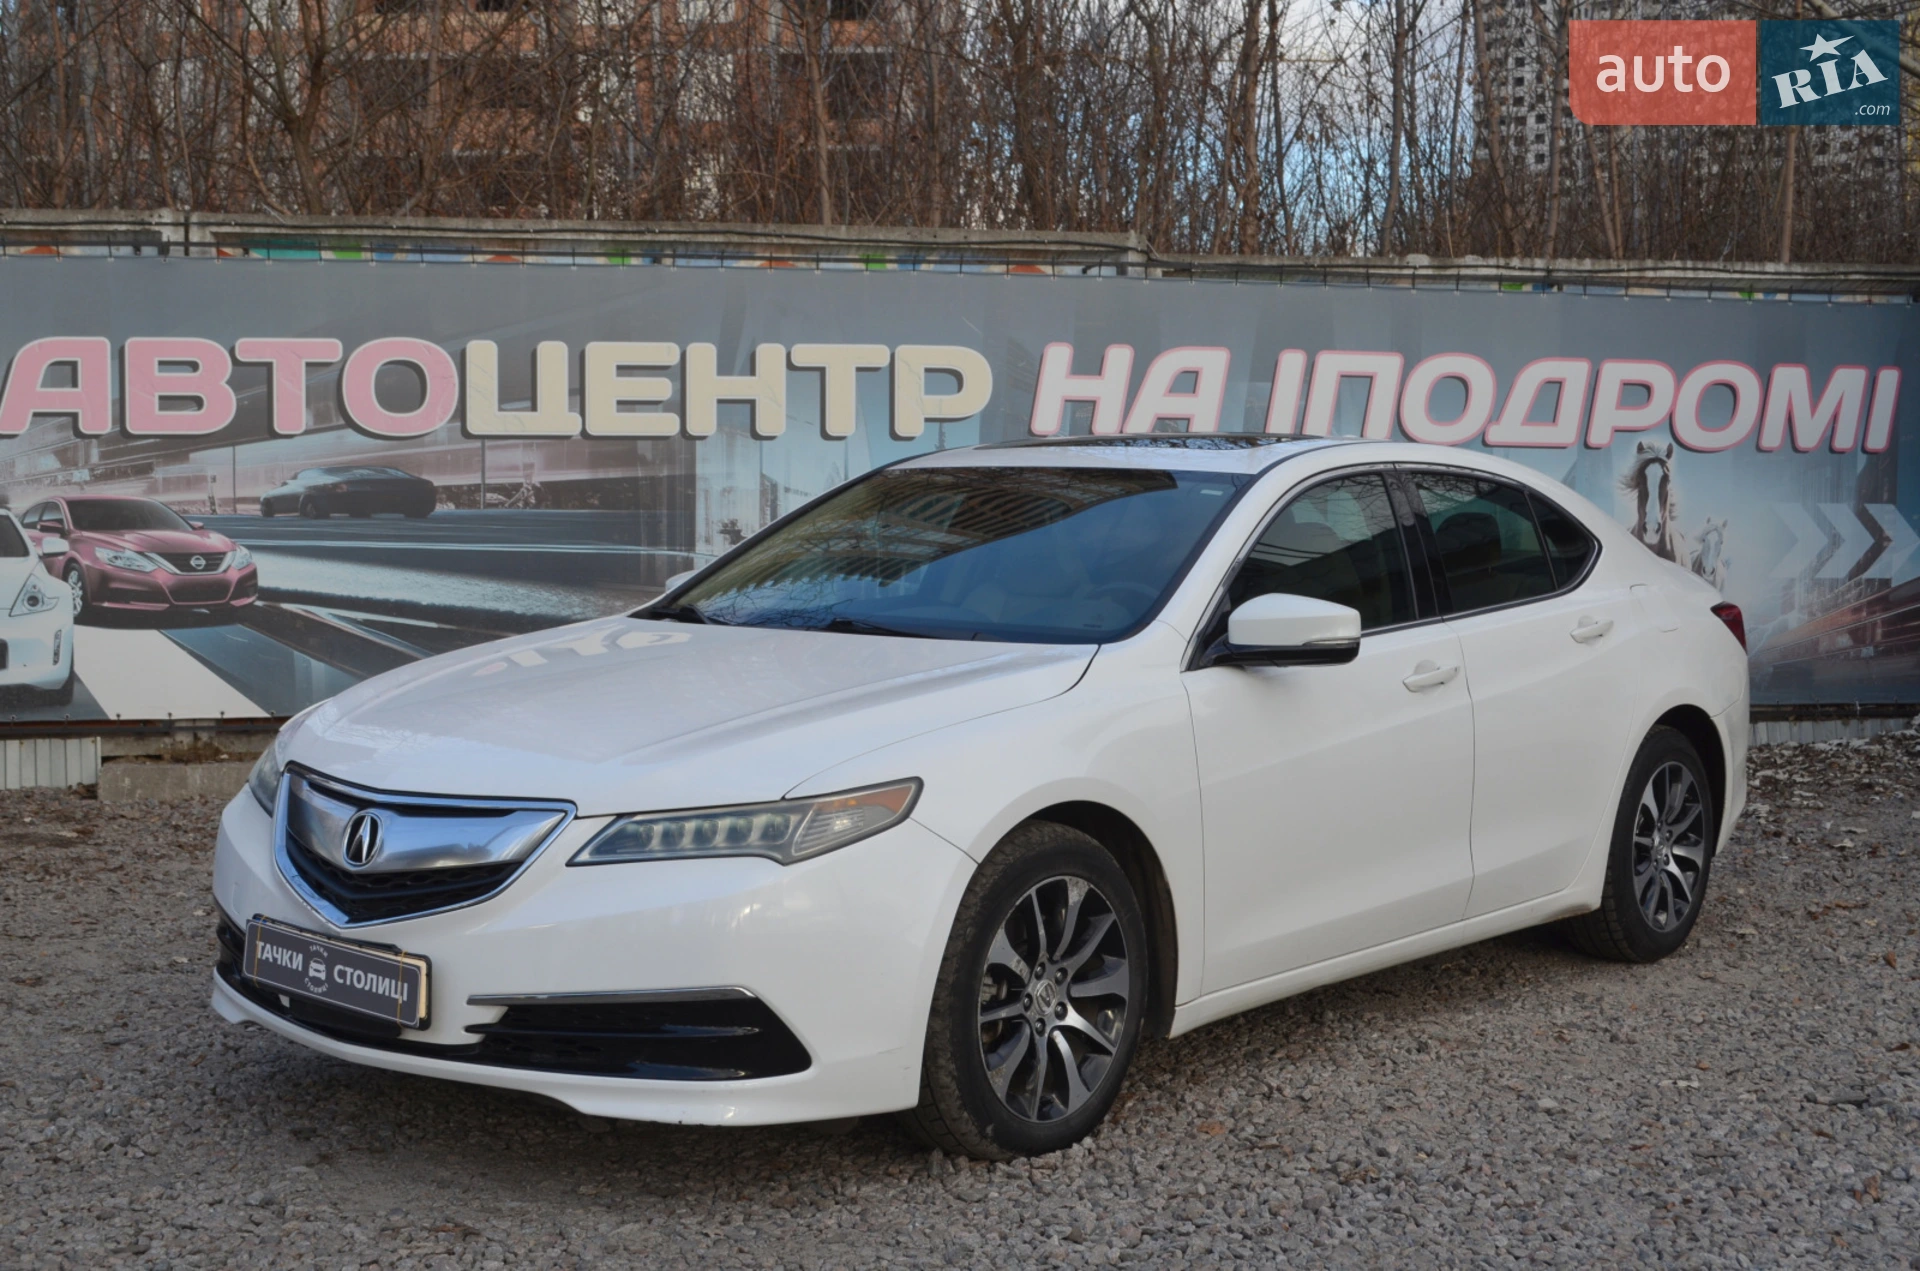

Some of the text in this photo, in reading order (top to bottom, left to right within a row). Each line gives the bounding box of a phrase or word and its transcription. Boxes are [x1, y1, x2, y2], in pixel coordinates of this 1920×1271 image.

[0, 336, 1901, 453] АВТОЦЕНТР НА ІПОДРОМІ
[256, 941, 408, 1004] ТАЧКИ СТОЛИЦІ
